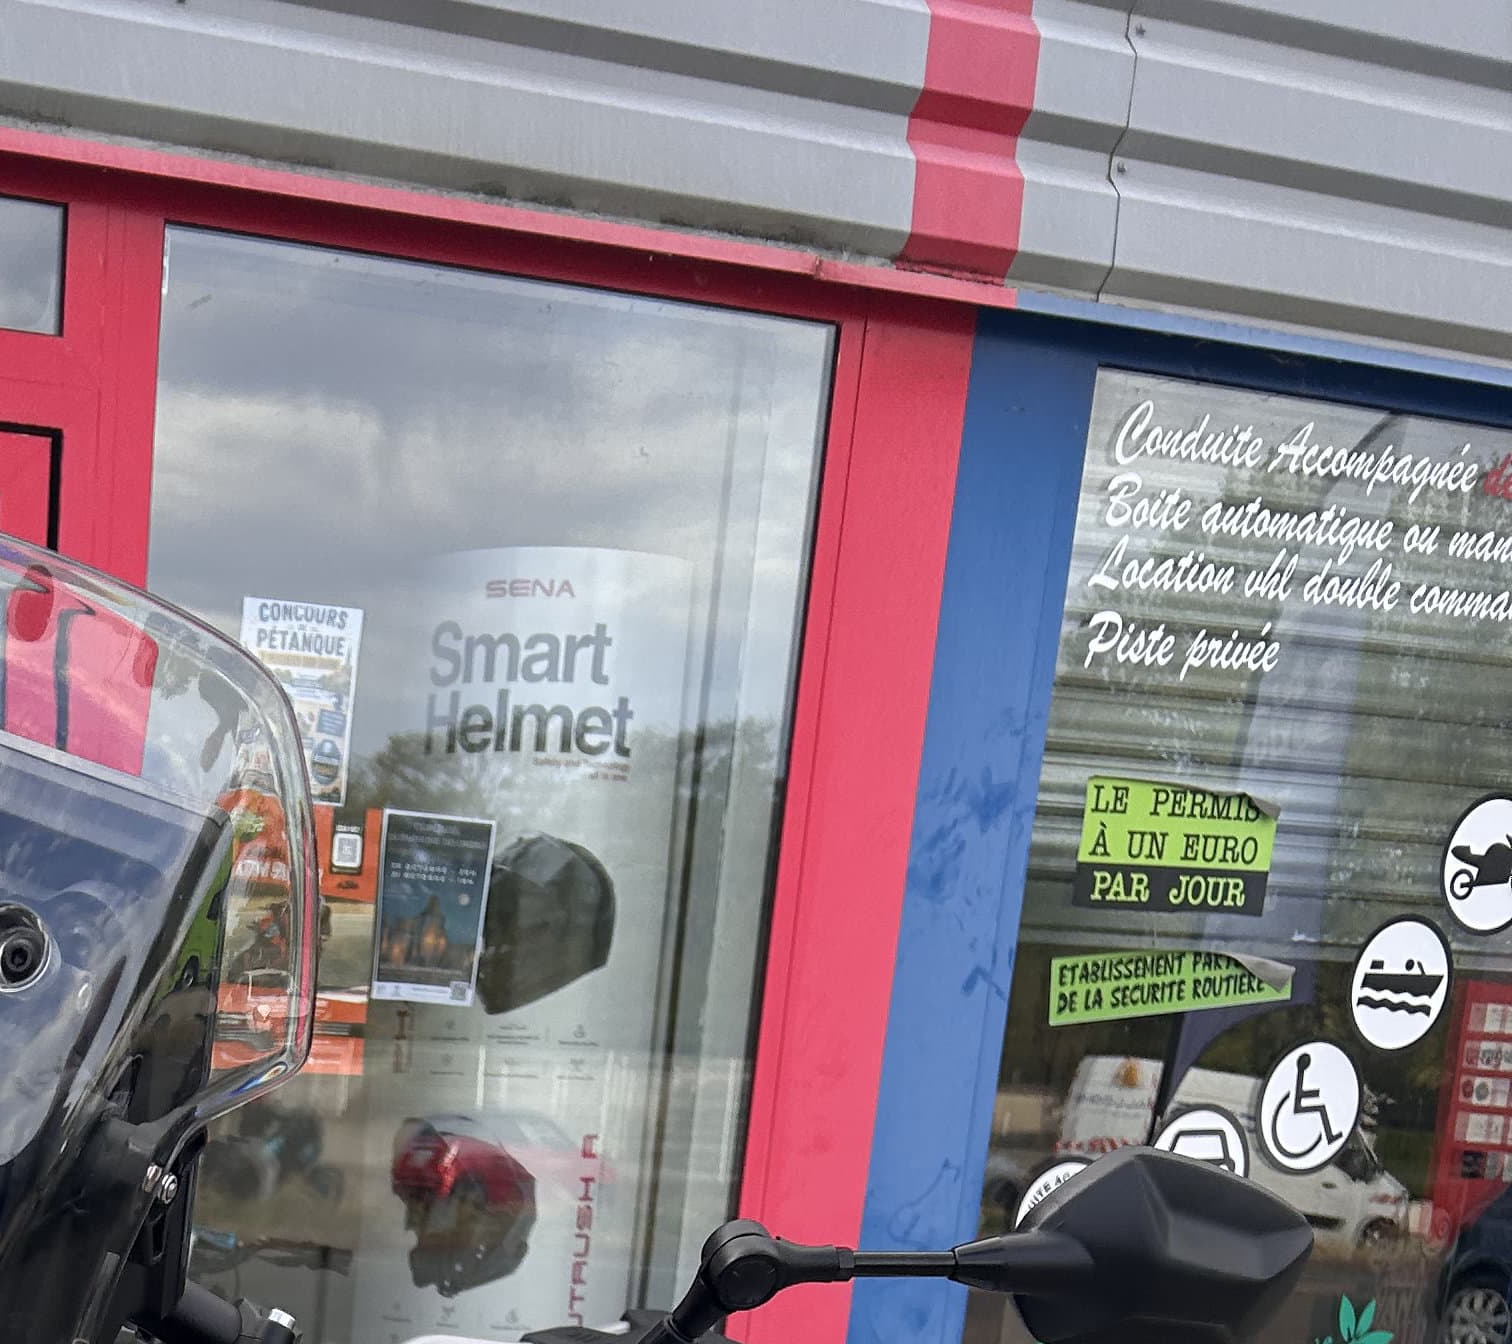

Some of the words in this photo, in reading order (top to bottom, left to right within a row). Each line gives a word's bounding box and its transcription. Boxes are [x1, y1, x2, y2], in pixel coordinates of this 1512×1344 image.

[1115, 400, 1263, 466] Conduite
[1268, 422, 1479, 503] Accompagnée
[1105, 472, 1192, 527] Boite
[1201, 497, 1393, 565] automatique
[1403, 524, 1440, 555] ou
[1448, 531, 1512, 563] man
[485, 579, 576, 599] SENA
[1088, 535, 1234, 591] Location
[1244, 548, 1295, 601] vhl
[1303, 558, 1400, 611] double
[1409, 583, 1512, 622] comma
[258, 602, 348, 630] CONCOURS
[256, 626, 345, 656] PÉTANQUE
[430, 620, 612, 687] Smart
[1083, 609, 1176, 669] Piste
[1179, 622, 1281, 681] privée
[425, 688, 634, 757] Helmet
[1091, 785, 1129, 814] LE
[1149, 787, 1261, 823] PERMIS
[1089, 821, 1111, 857] À
[1128, 830, 1168, 860] UN
[1180, 833, 1259, 865] EURO
[1090, 870, 1150, 903] PAR
[1168, 875, 1246, 907] JOUR
[1058, 953, 1186, 987] ETABLISSEMENT
[1056, 990, 1077, 1014] DE
[1084, 986, 1102, 1013] LA
[1111, 979, 1186, 1009] SECURITE
[568, 1177, 595, 1327] UTRUSH
